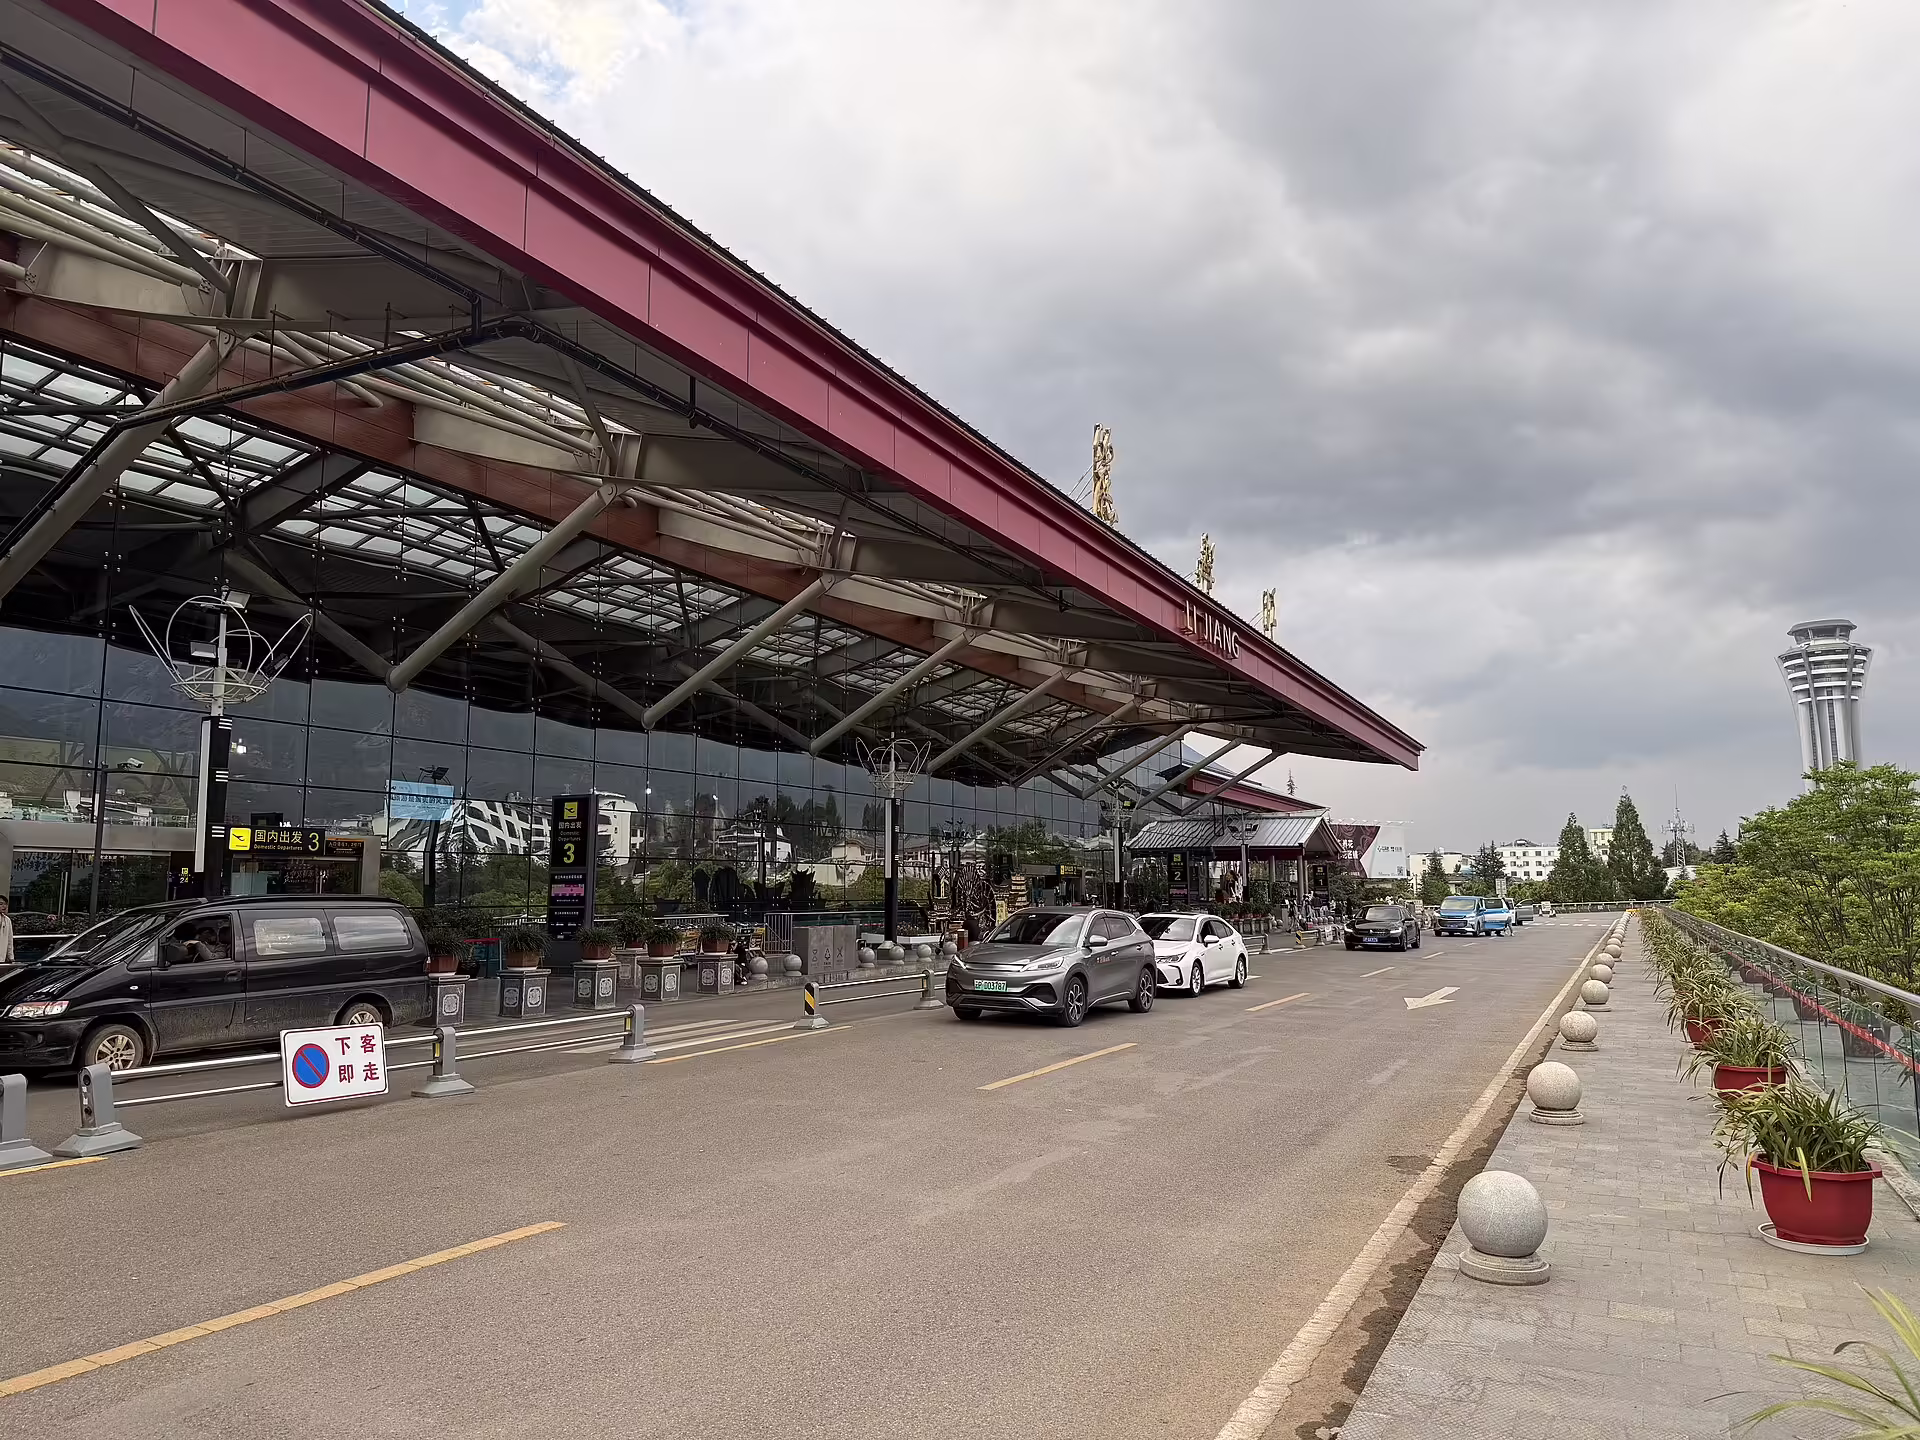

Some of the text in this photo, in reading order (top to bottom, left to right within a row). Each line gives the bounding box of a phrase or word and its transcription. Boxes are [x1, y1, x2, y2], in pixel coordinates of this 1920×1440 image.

[1186, 600, 1197, 634] LI
[1203, 612, 1240, 659] JIANG
[558, 821, 582, 829] 国内出发
[254, 829, 320, 852] 国内出发 3
[254, 843, 276, 851] Domestic
[563, 843, 575, 863] 3
[1174, 871, 1181, 881] 2
[335, 1034, 376, 1056] 下客
[338, 1062, 380, 1084] 即走
